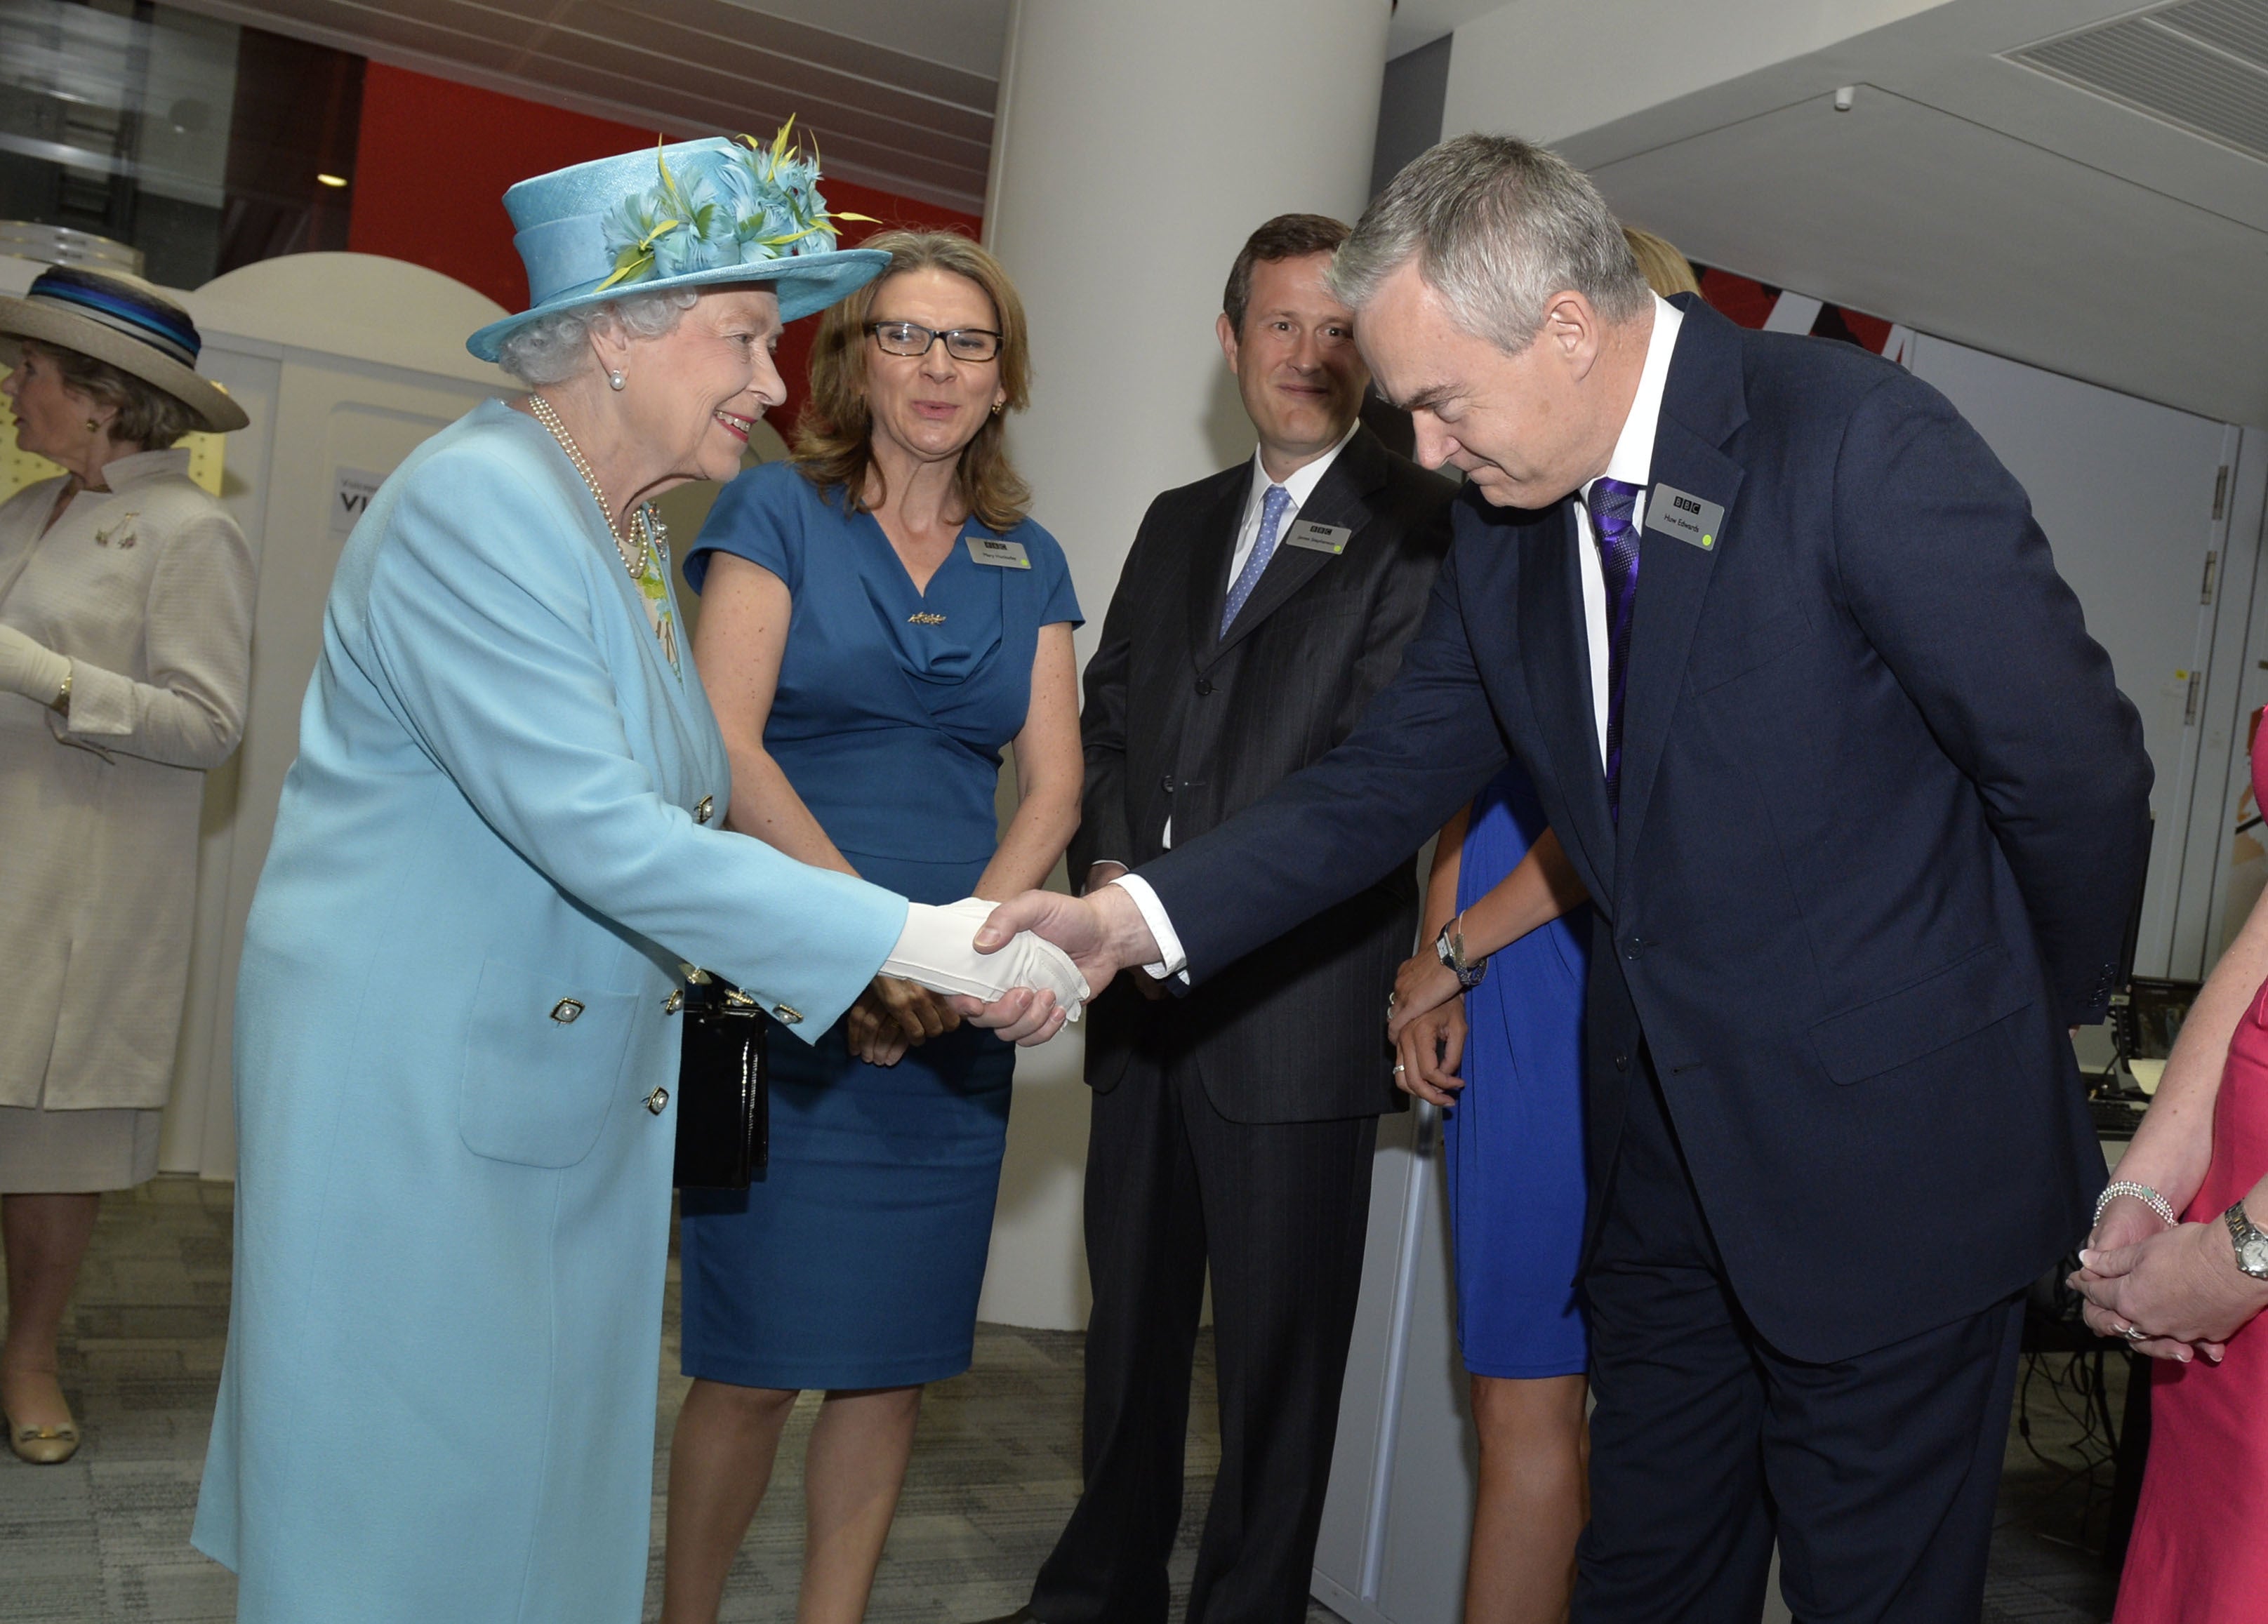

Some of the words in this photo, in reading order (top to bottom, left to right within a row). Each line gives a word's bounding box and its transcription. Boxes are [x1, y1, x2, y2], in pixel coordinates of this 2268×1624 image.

[1673, 495, 1702, 515] BBC
[1310, 526, 1333, 535] BBC
[1677, 519, 1700, 533] Edwards
[983, 541, 1007, 551] BBC
